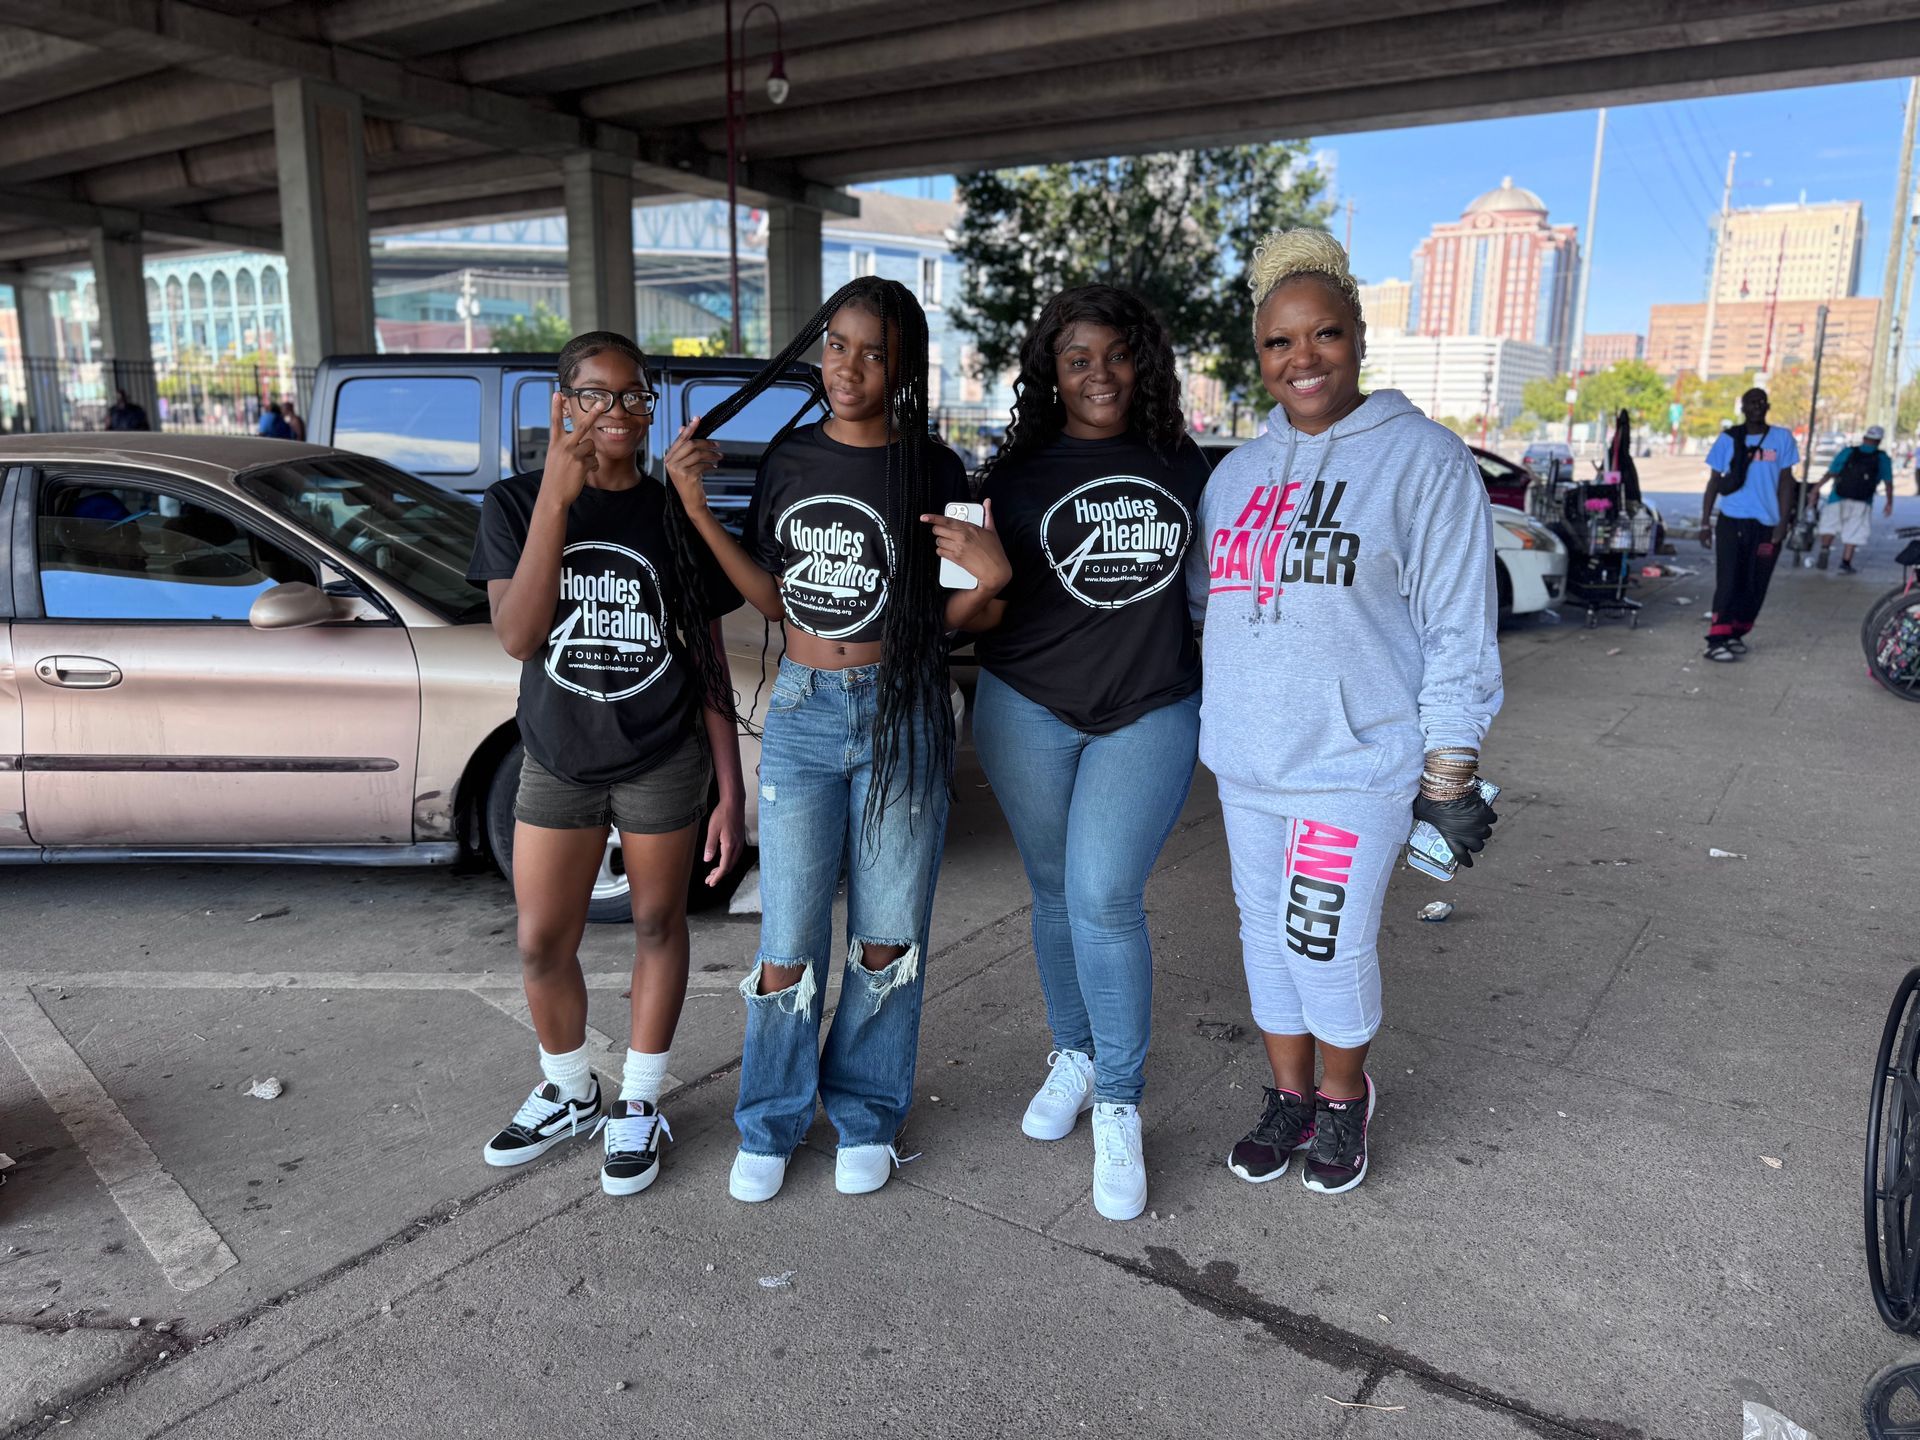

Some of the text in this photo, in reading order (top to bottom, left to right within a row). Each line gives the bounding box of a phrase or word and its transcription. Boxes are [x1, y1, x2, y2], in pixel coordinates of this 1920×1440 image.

[1074, 496, 1158, 524] Hoodies
[1234, 480, 1347, 531] HEAL
[790, 519, 865, 558] Hoodies
[1101, 515, 1181, 557] Healing
[808, 551, 880, 593] Healing
[1085, 564, 1164, 573] FOUNDATION
[1210, 528, 1360, 587] CANCER
[560, 567, 641, 605] Hoodies
[582, 600, 662, 648] Healing
[567, 651, 654, 663] FOUNDATION
[1285, 819, 1359, 961] ANCER
[1328, 1102, 1347, 1110] FILA
